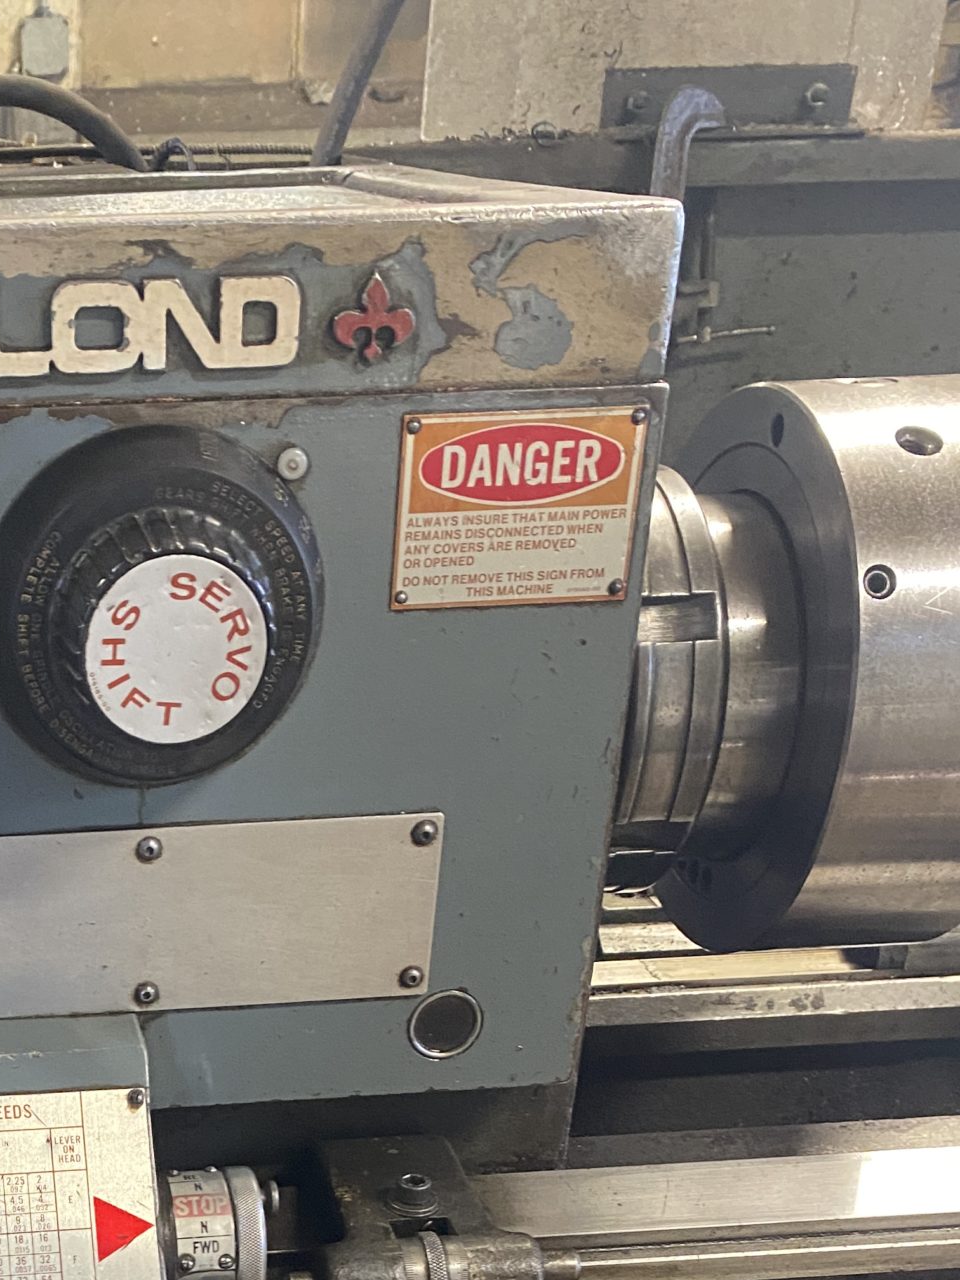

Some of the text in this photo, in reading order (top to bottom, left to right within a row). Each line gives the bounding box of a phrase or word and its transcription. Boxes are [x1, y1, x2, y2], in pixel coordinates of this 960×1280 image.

[441, 439, 602, 489] DANGER
[213, 481, 262, 515] SELECT
[264, 520, 295, 563] SPEED
[406, 508, 626, 528] ALWAYS INSURE THAT MAIN POWER
[405, 524, 602, 541] REMAINS DISCONNECTED WHEN
[404, 538, 576, 555] ANY COVERS ARE REMOVED
[404, 557, 474, 568] OR OPENED
[403, 568, 604, 587] DO NOT REMOVE THIS SIGN FROM
[466, 584, 553, 597] THIS MACHINE
[171, 573, 252, 701] SERVO
[101, 599, 182, 726] SHIFT
[54, 1136, 81, 1145] LEVER
[63, 1145, 75, 1154] ON
[58, 1154, 81, 1163] HEAD
[176, 1196, 226, 1216] STOP
[200, 1222, 208, 1233] N
[15, 1235, 24, 1244] 18
[39, 1234, 48, 1242] 16
[193, 1241, 219, 1253] FWD
